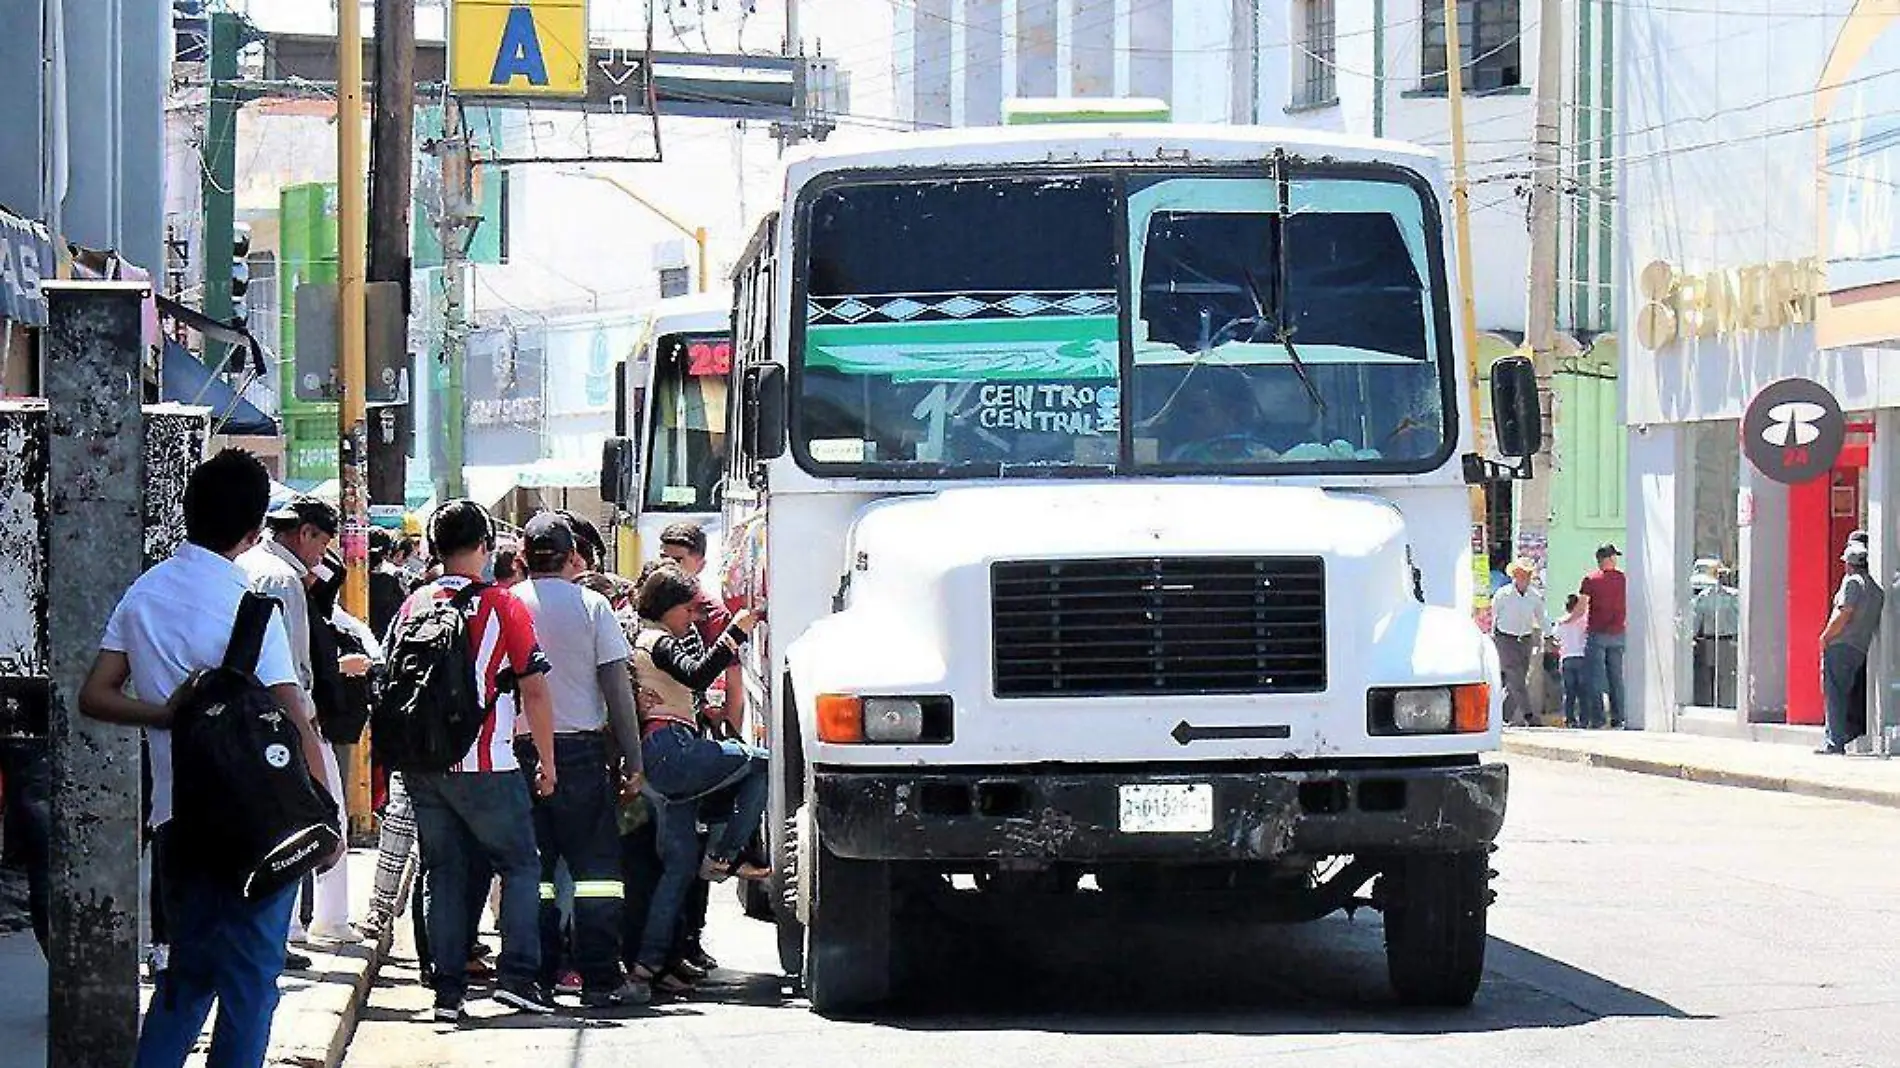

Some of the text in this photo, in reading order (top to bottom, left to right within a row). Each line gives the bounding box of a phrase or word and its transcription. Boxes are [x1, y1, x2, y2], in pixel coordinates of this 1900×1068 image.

[490, 7, 549, 86] A
[979, 384, 1095, 410] CENTRO
[979, 407, 1101, 437] CENTRAL
